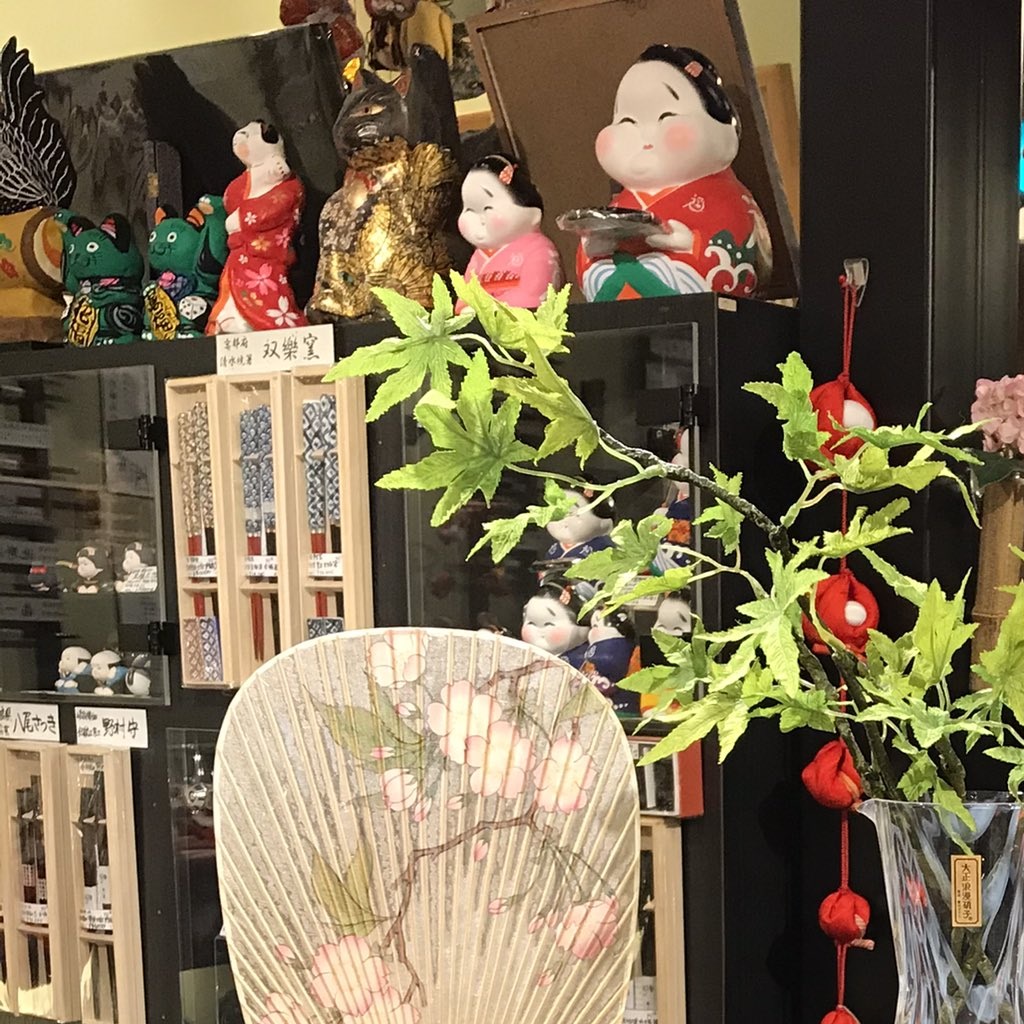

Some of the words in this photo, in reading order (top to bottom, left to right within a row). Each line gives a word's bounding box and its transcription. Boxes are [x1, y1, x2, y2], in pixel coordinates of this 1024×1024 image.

[961, 863, 972, 919] 大正浪漫硝子
